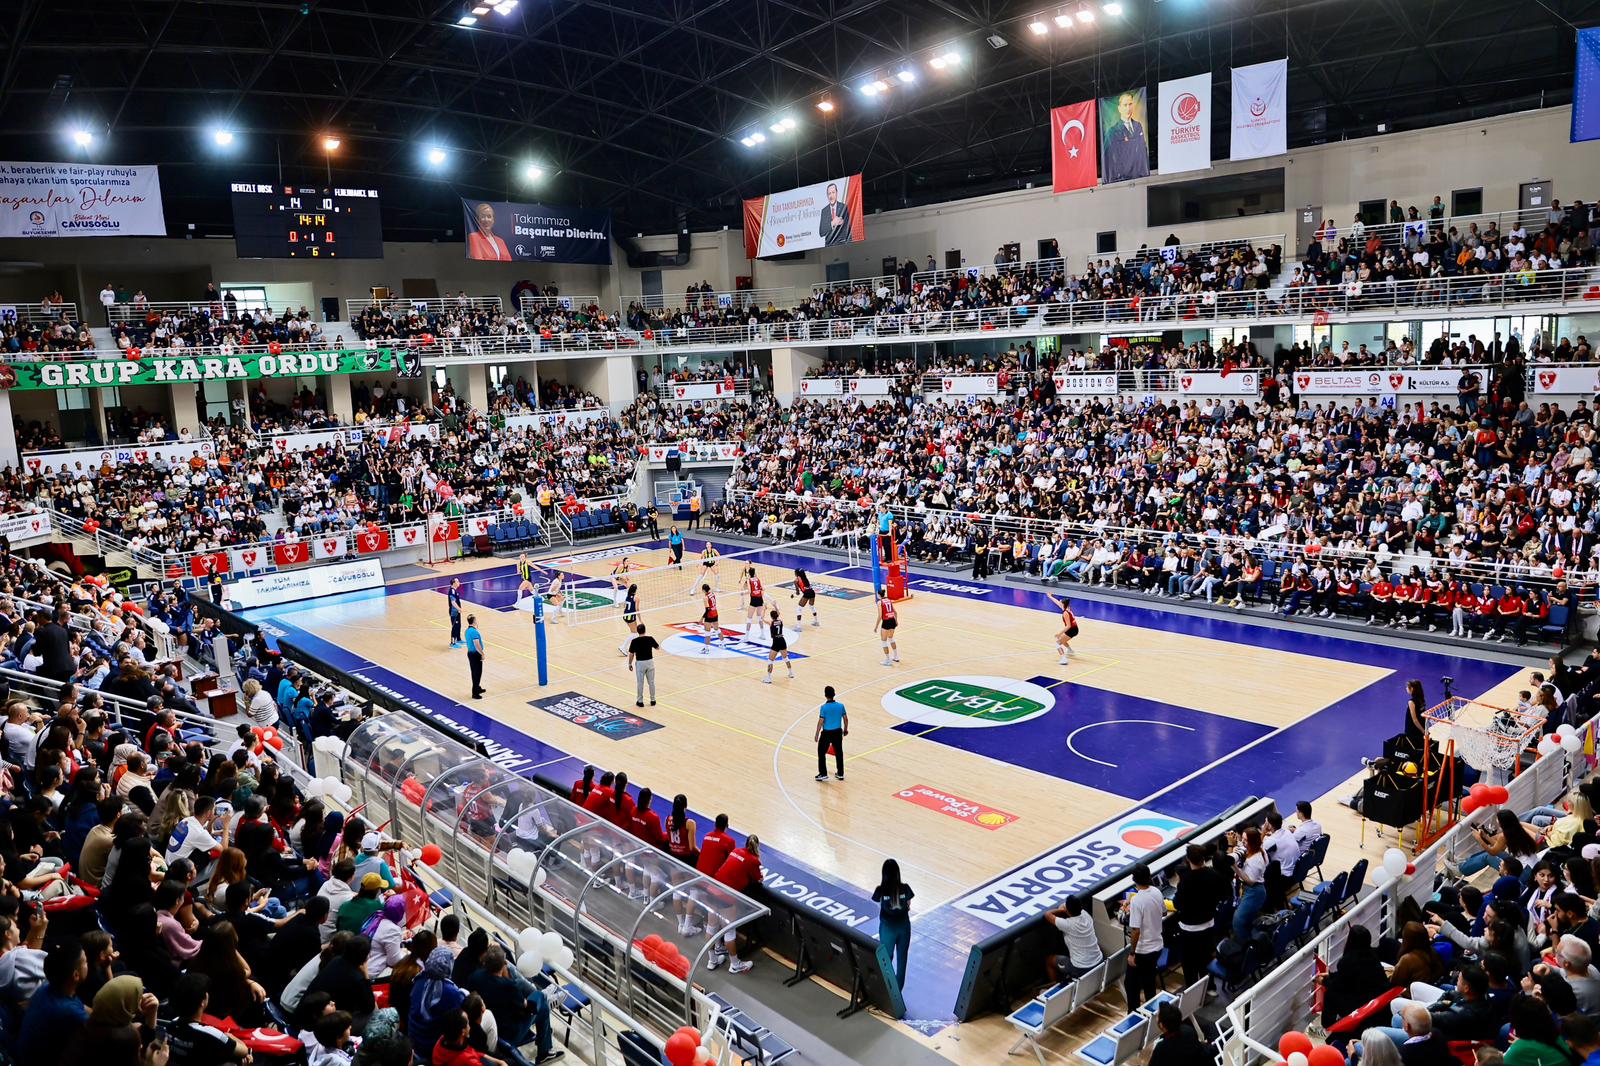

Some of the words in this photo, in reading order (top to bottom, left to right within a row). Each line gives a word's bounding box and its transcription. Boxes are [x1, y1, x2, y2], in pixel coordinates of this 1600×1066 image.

[1171, 125, 1200, 135] TÜRKİYE
[11, 166, 56, 175] beraberlik
[70, 166, 104, 178] fair-play
[107, 168, 137, 177] ruhuyla
[27, 178, 50, 186] çıkan
[52, 177, 68, 185] tüm
[70, 178, 130, 186] sporcularımıza
[290, 198, 300, 208] 14
[322, 198, 332, 209] 10
[514, 213, 570, 226] Takımımıza
[514, 226, 565, 239] Başarılar
[566, 226, 607, 240] Dilerim.
[1162, 249, 1174, 261] E3
[41, 360, 140, 386] GRUP
[153, 356, 248, 381] KARA
[258, 353, 338, 376] ORDU
[1066, 378, 1102, 388] BOSTON
[1382, 397, 1394, 406] A4
[352, 432, 362, 440] D3
[118, 452, 130, 461] D2
